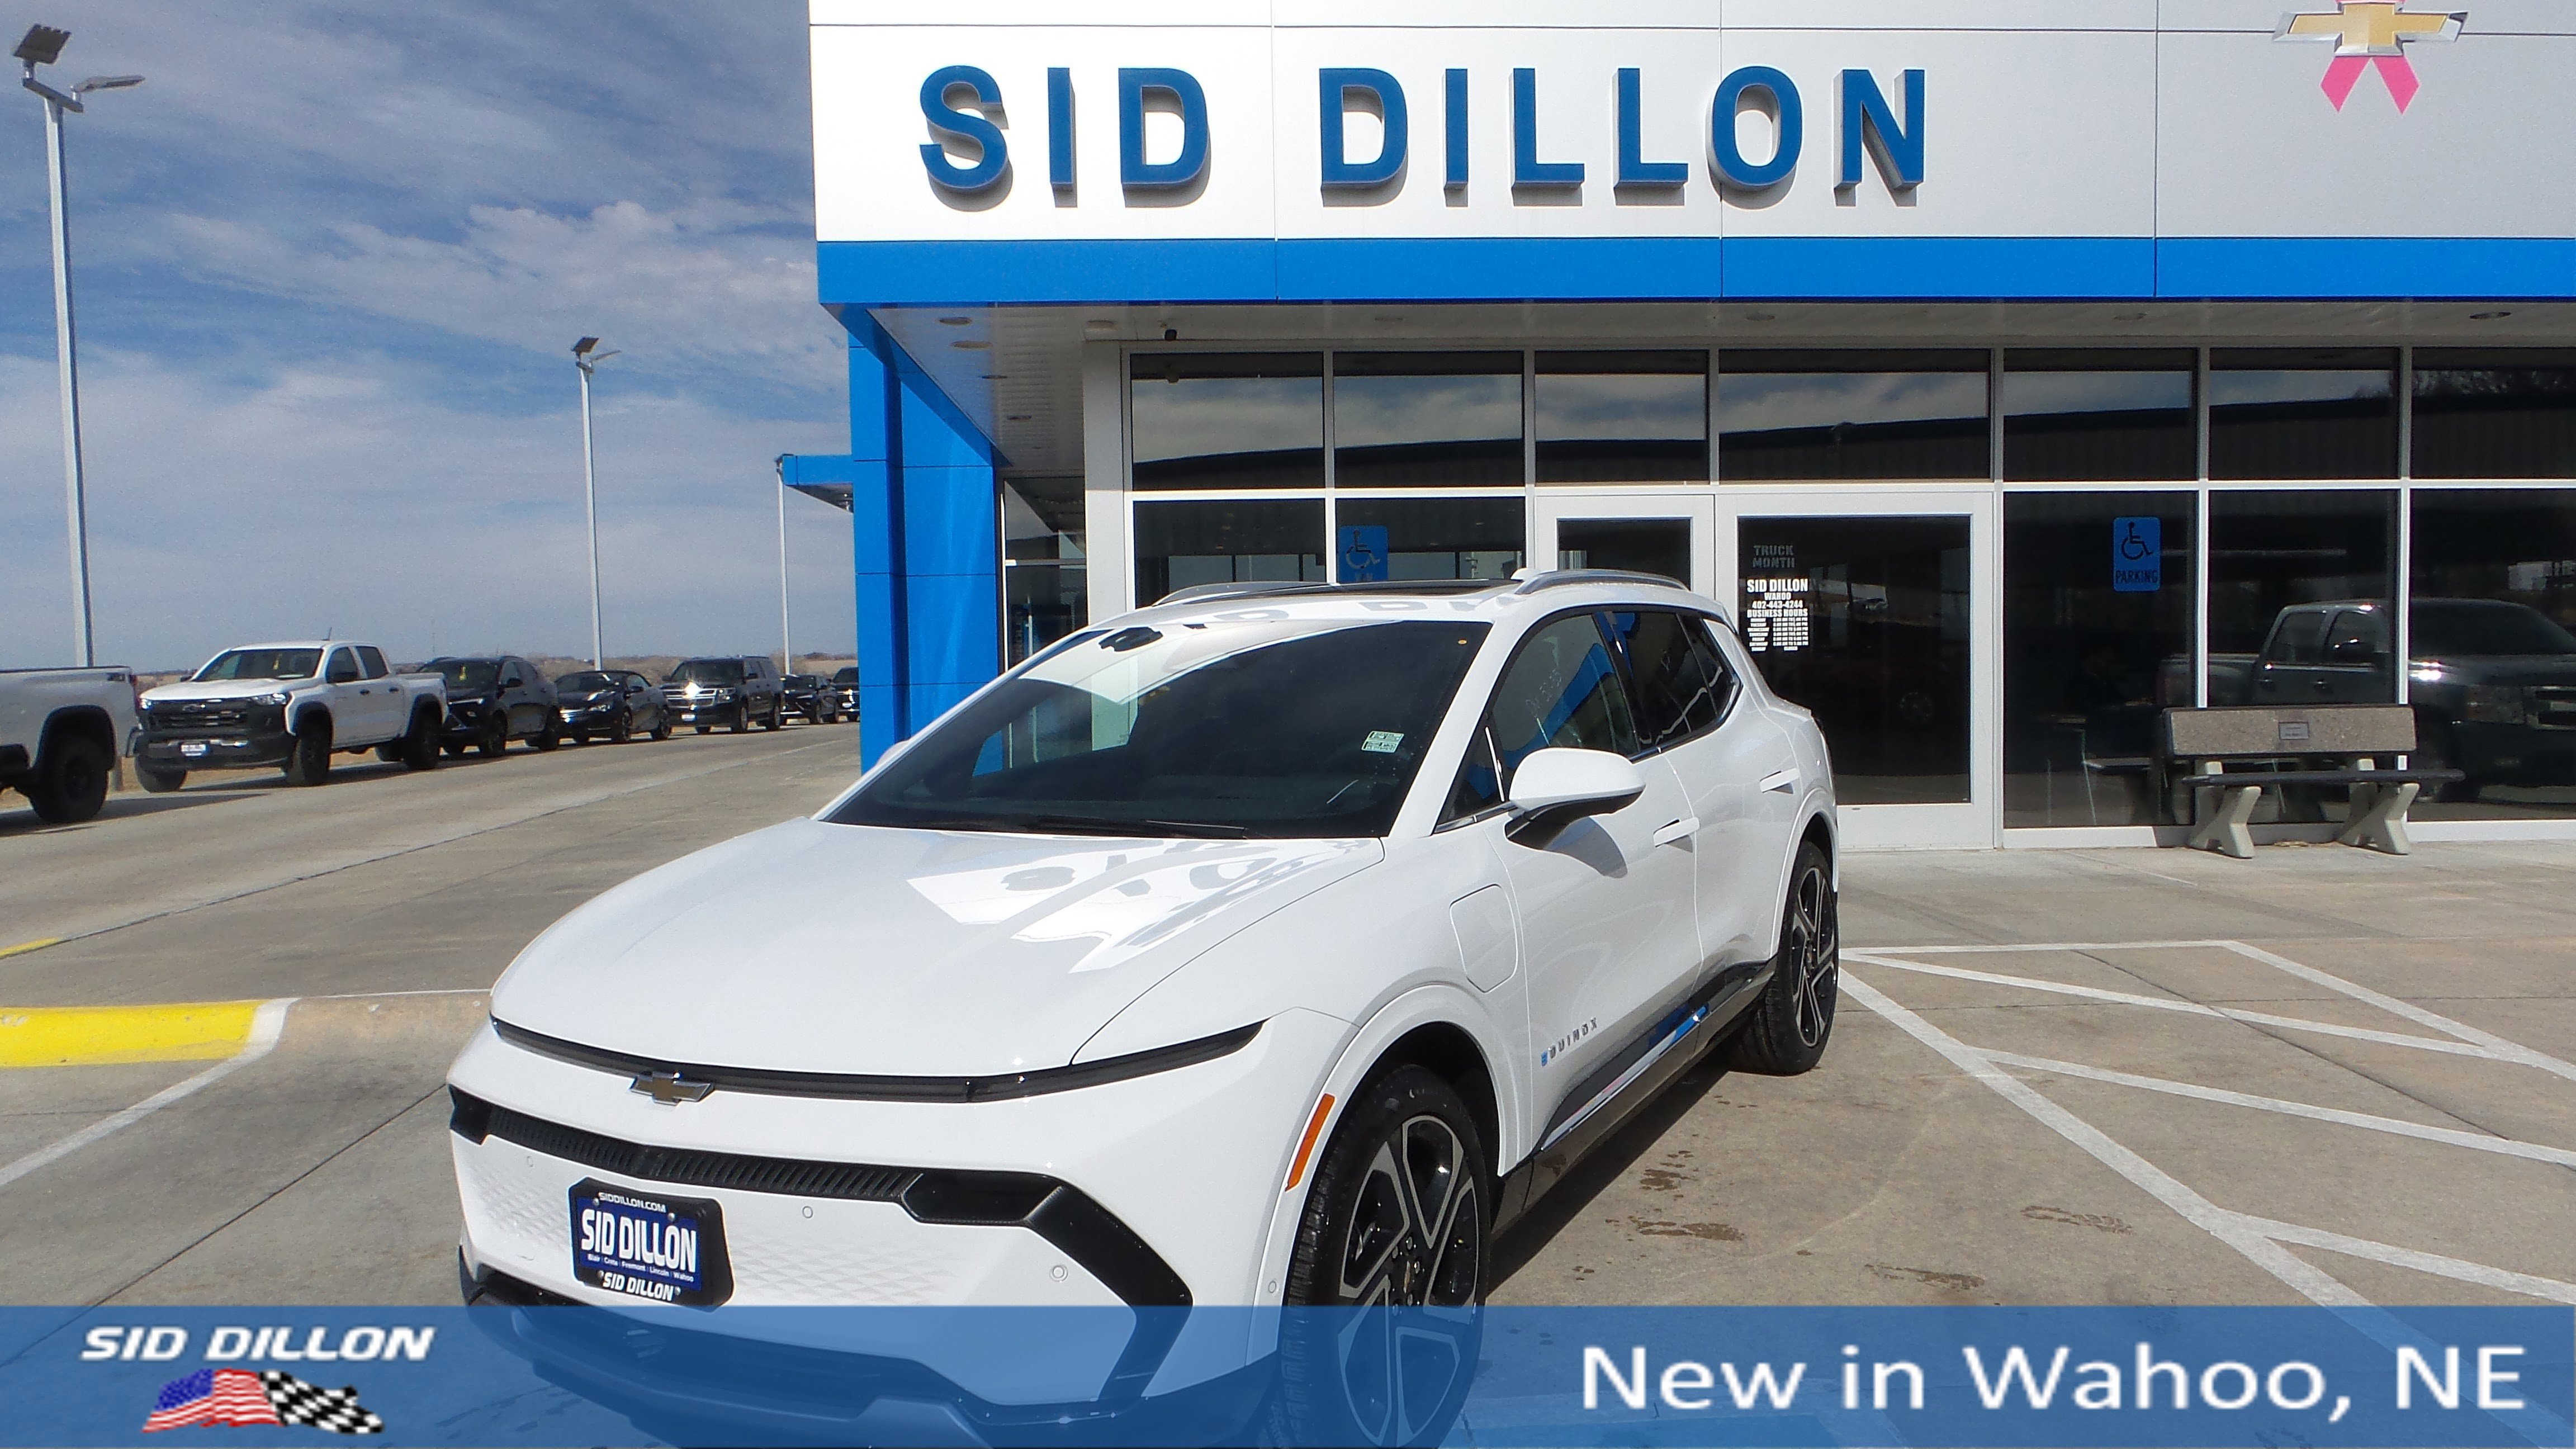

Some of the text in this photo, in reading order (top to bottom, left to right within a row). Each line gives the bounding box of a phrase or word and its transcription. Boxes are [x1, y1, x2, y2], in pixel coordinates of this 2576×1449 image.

[920, 65, 1925, 189] SID DILLON
[1754, 545, 1793, 556] TRUCK
[1752, 557, 1795, 568] MONTH
[2115, 570, 2158, 584] PARKING
[1747, 578, 1808, 593] SID DILLON
[1752, 600, 1803, 609] 402-443-4244
[1747, 608, 1808, 618] BUSINESS HOURS
[1541, 1017, 1597, 1067] EQUINOX
[598, 1192, 666, 1213] SIDDILLON.COM
[581, 1209, 697, 1273] SID DILLON
[603, 1272, 674, 1301] SID DILLON
